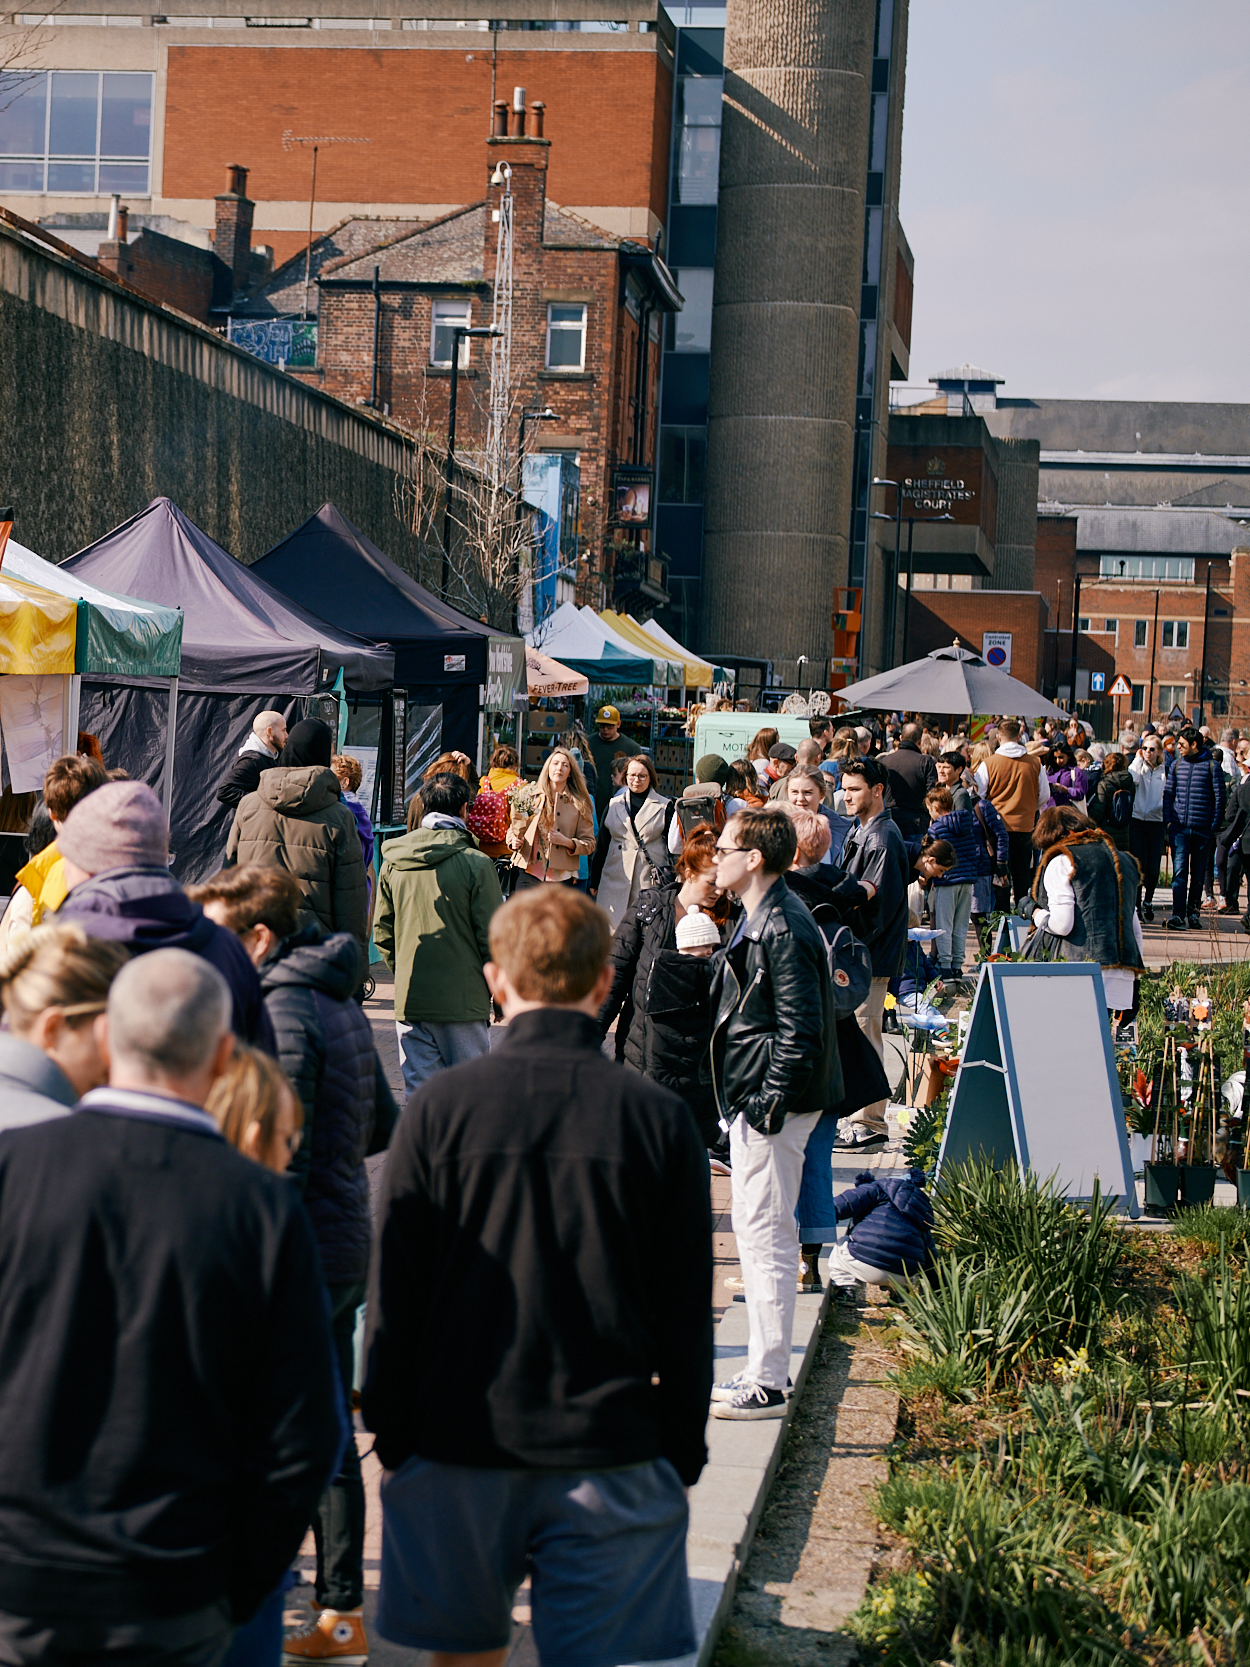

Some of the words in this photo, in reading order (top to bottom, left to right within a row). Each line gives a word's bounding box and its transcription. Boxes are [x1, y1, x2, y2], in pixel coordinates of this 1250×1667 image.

[904, 478, 965, 490] SHEFFIELD
[914, 499, 954, 510] COURT
[532, 682, 578, 694] FEVER-TREE
